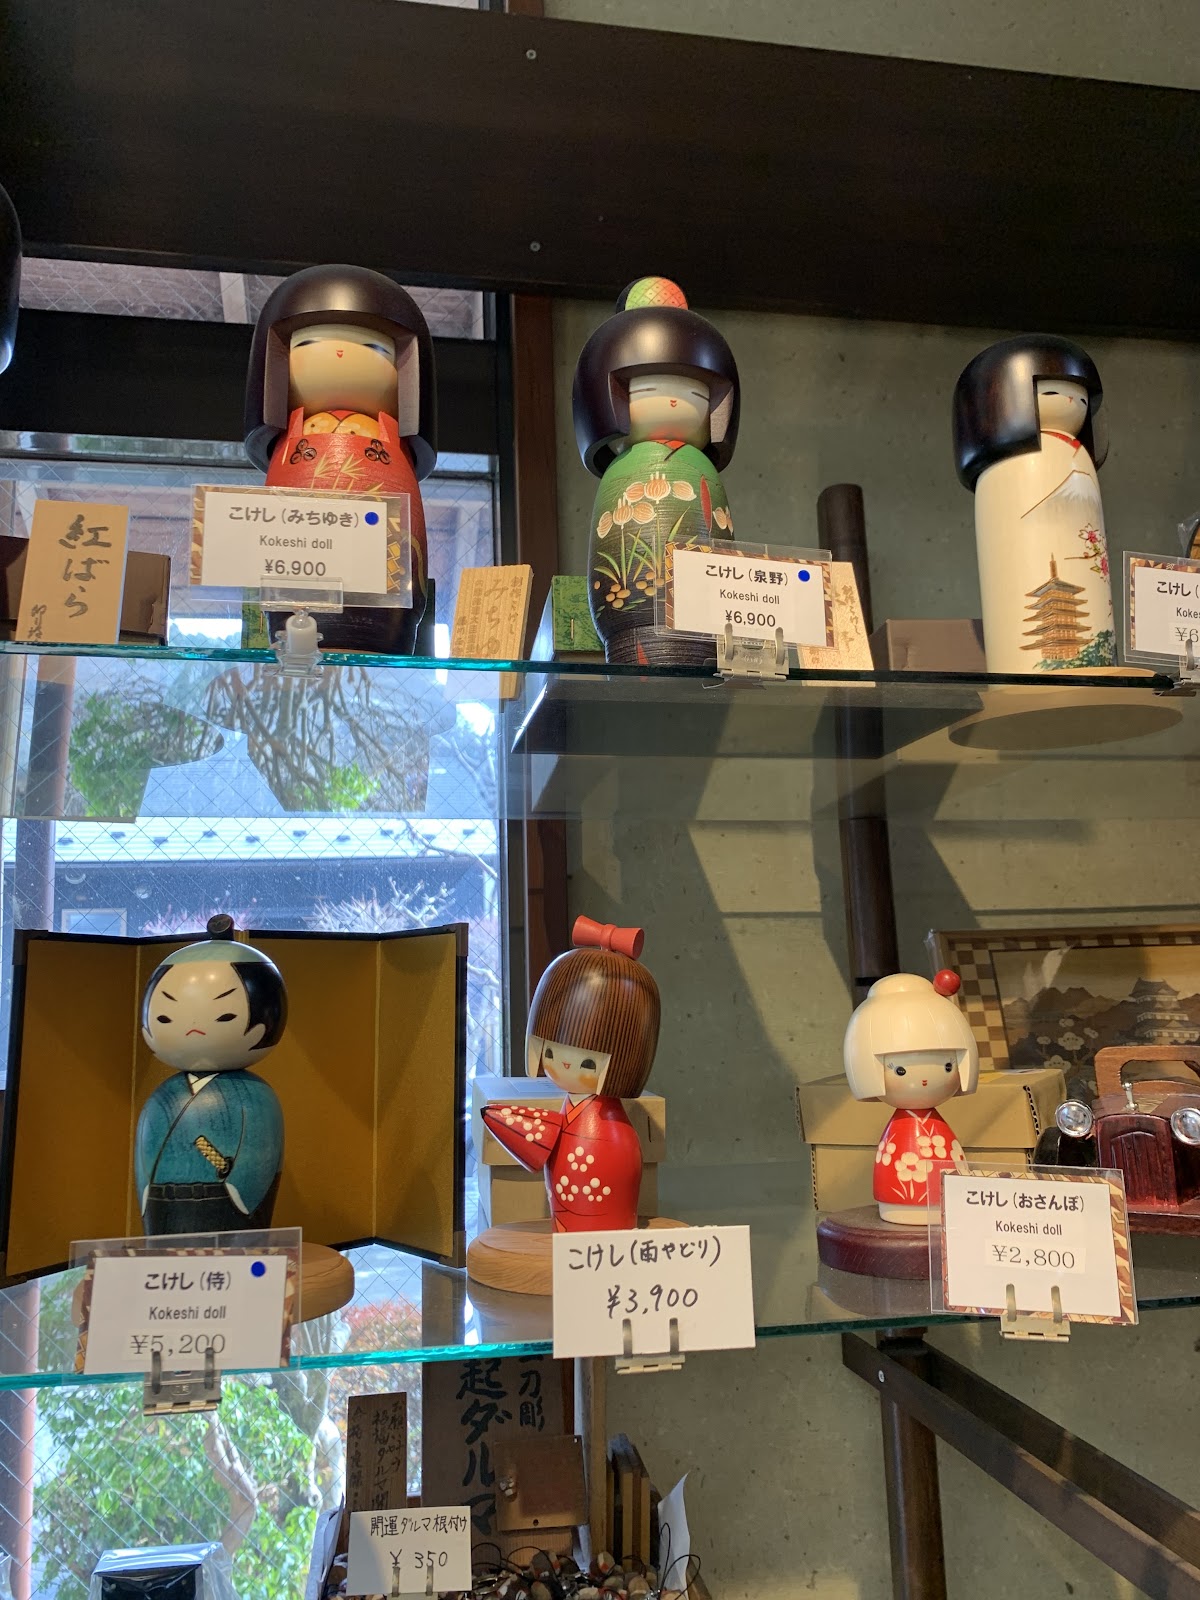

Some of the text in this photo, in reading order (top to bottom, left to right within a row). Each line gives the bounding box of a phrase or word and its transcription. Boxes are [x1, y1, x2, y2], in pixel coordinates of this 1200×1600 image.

[228, 506, 359, 528] こけし（みちゆき）
[259, 535, 333, 550] Kokeshi doll
[58, 514, 112, 618] 紅ばら
[264, 558, 326, 576] ¥6,900
[705, 564, 788, 586] こけし（泉野）
[719, 589, 780, 605] Kokeshi doll
[725, 609, 776, 628] ¥6,900
[966, 1190, 1085, 1213] こけし（おさんぽ）
[995, 1220, 1063, 1236] Kokeshi doll
[568, 1235, 721, 1271] こけし（雨やどり）
[991, 1244, 1075, 1269] ¥2,800
[144, 1271, 232, 1291] こけし（侍）
[606, 1284, 698, 1319] ¥3,900
[149, 1306, 227, 1320] Kokeshi doll
[130, 1333, 226, 1356] ¥5,200
[370, 1514, 468, 1538] 開運ダルマ根付け
